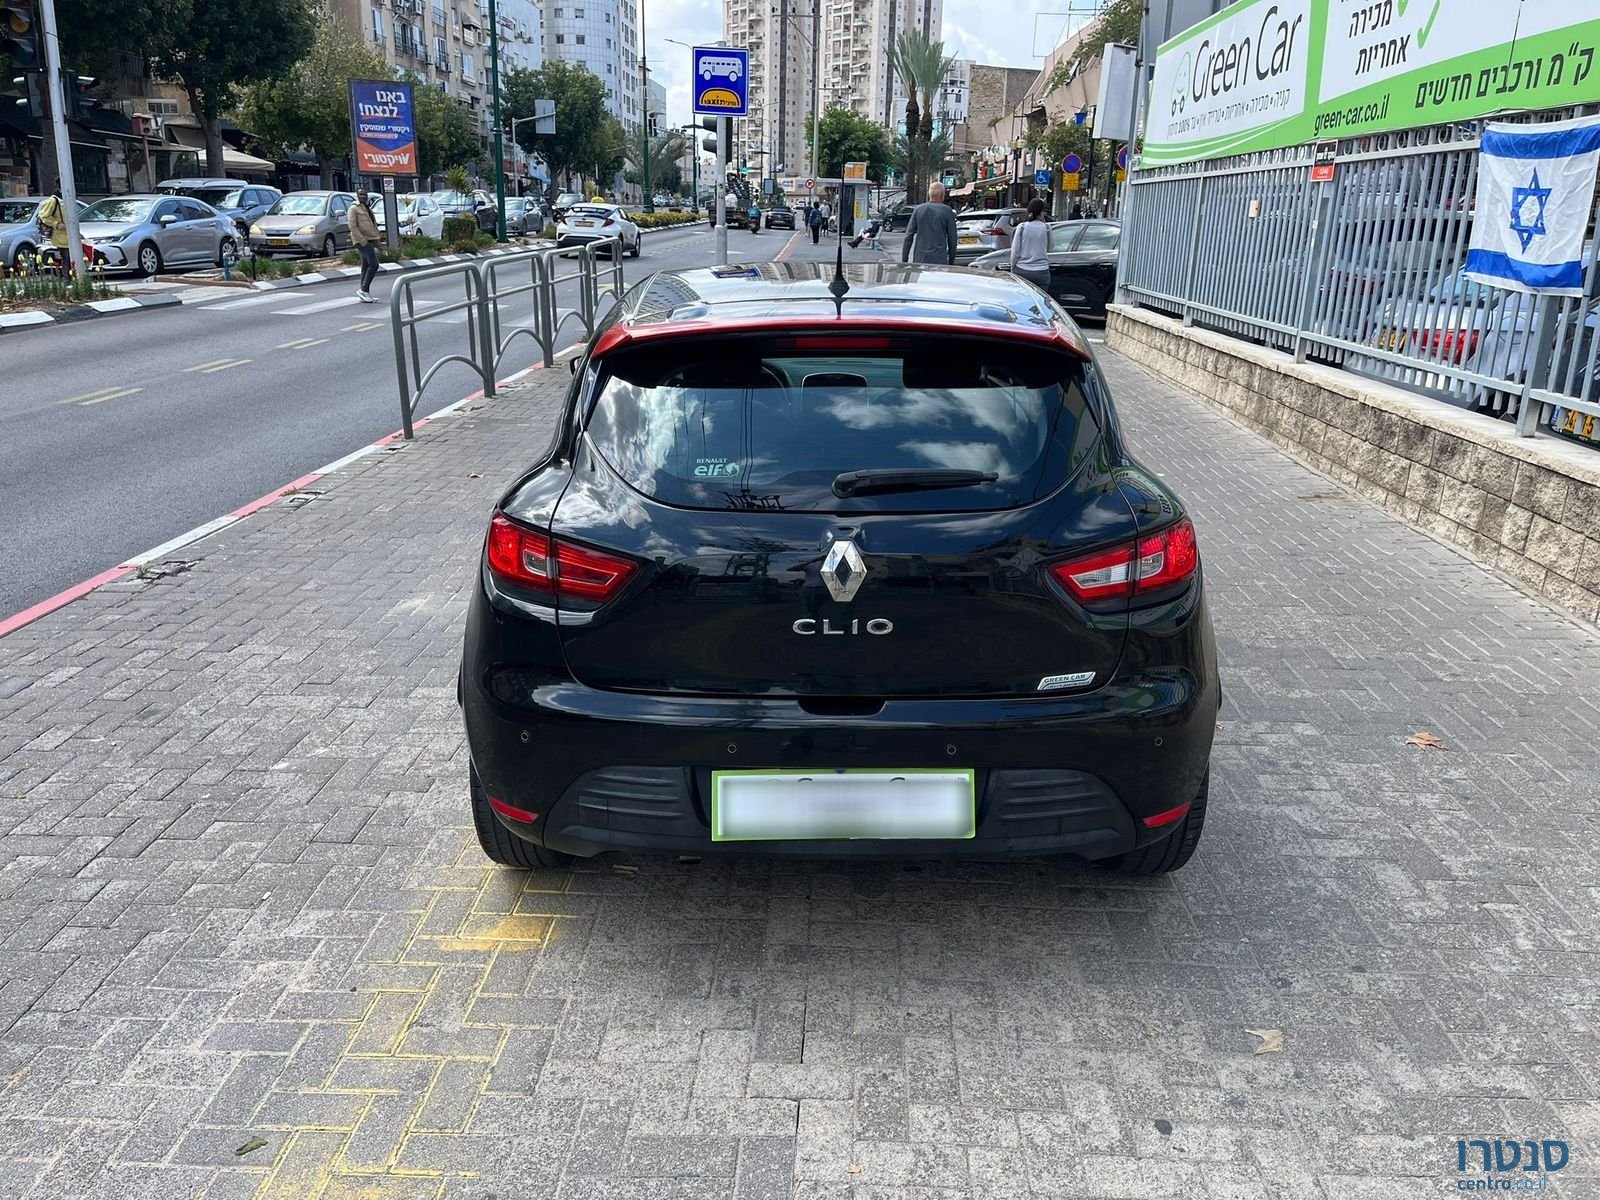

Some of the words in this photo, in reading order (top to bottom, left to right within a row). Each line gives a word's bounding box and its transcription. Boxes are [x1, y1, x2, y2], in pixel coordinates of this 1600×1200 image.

[1348, 0, 1393, 38] מכירה
[1192, 36, 1251, 103] Green
[1255, 5, 1303, 81] Car
[1355, 34, 1411, 75] אחריות
[1414, 73, 1473, 108] חדשים
[1475, 58, 1543, 98] ורכבים
[358, 102, 398, 117] לנצח!
[375, 90, 407, 104] באנו
[1314, 93, 1390, 137] green-car.co.il
[694, 463, 724, 476] elf
[792, 618, 894, 635] CLIO
[1044, 676, 1070, 684] GREEN
